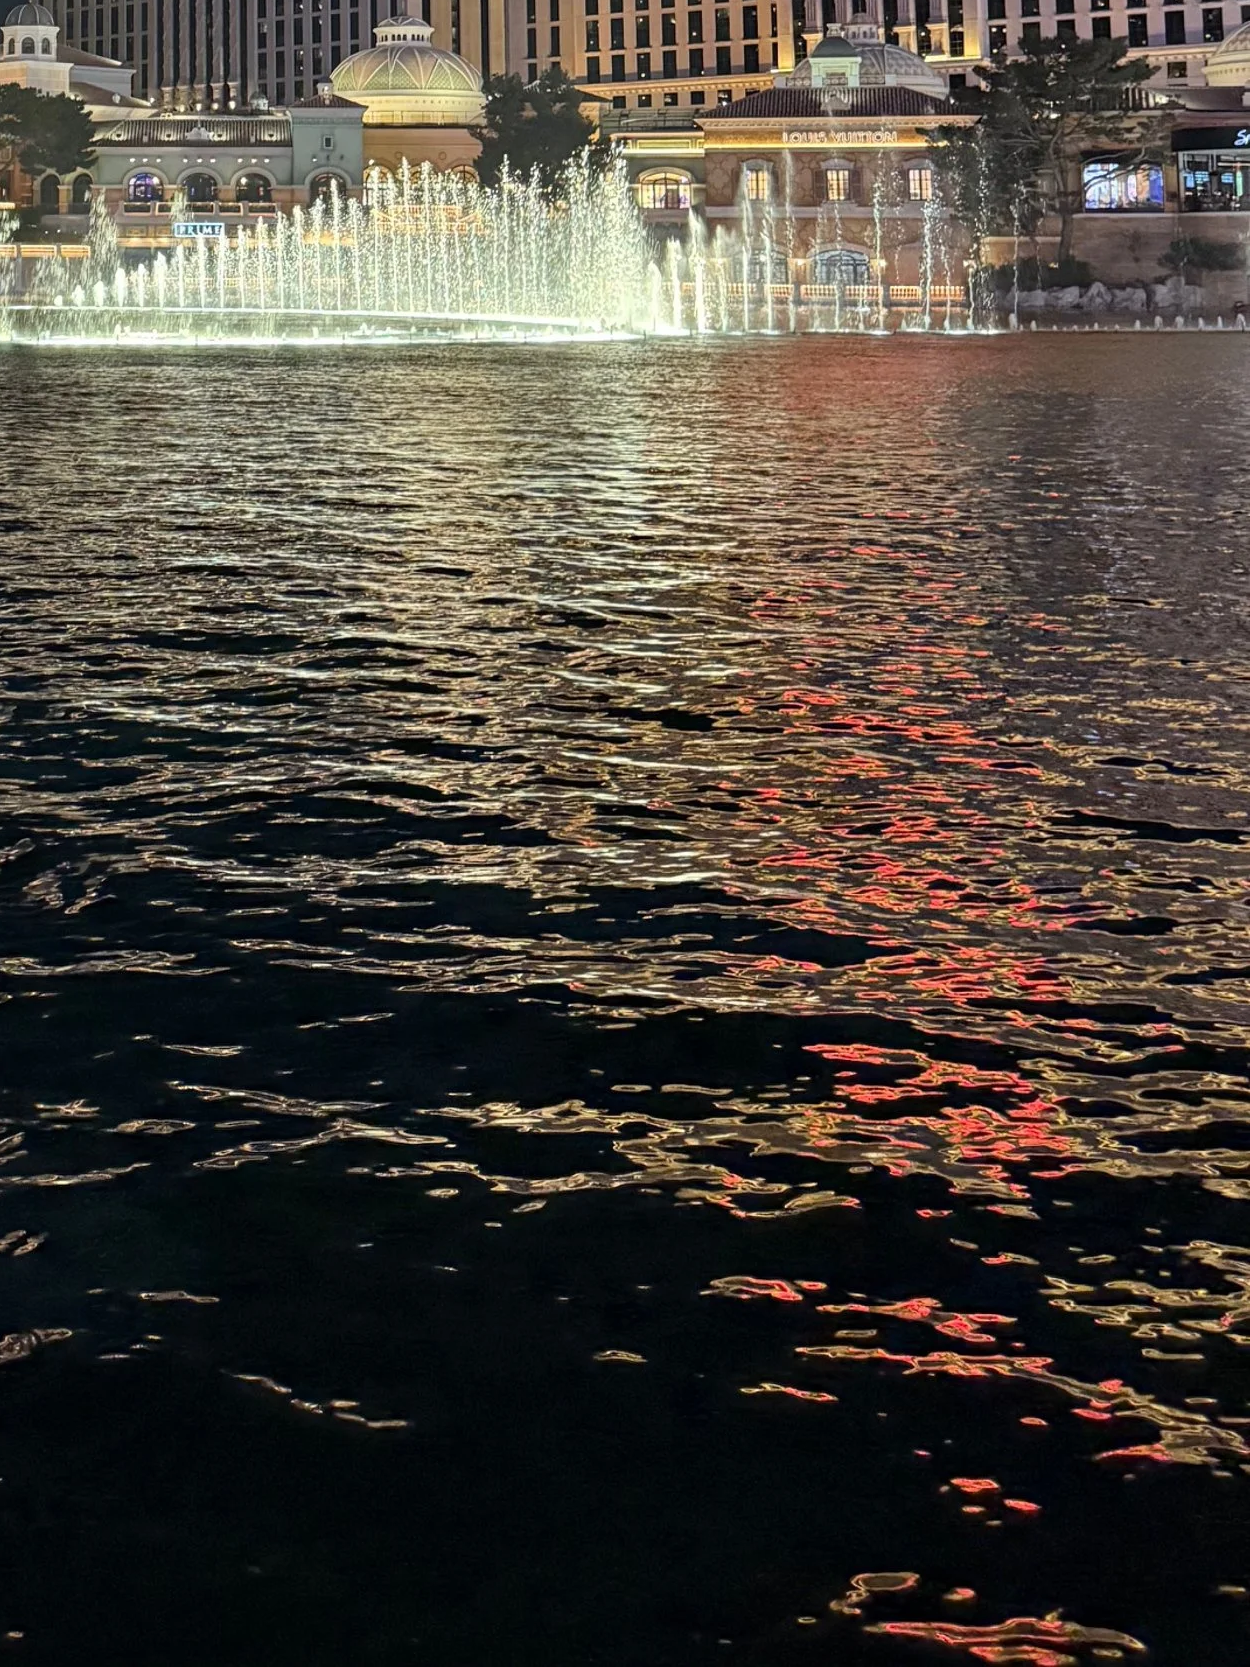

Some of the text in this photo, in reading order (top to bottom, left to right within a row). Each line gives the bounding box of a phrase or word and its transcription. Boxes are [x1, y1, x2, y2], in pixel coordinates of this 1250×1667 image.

[782, 130, 898, 144] LOUIS VUITTON
[179, 224, 221, 235] PRIME
